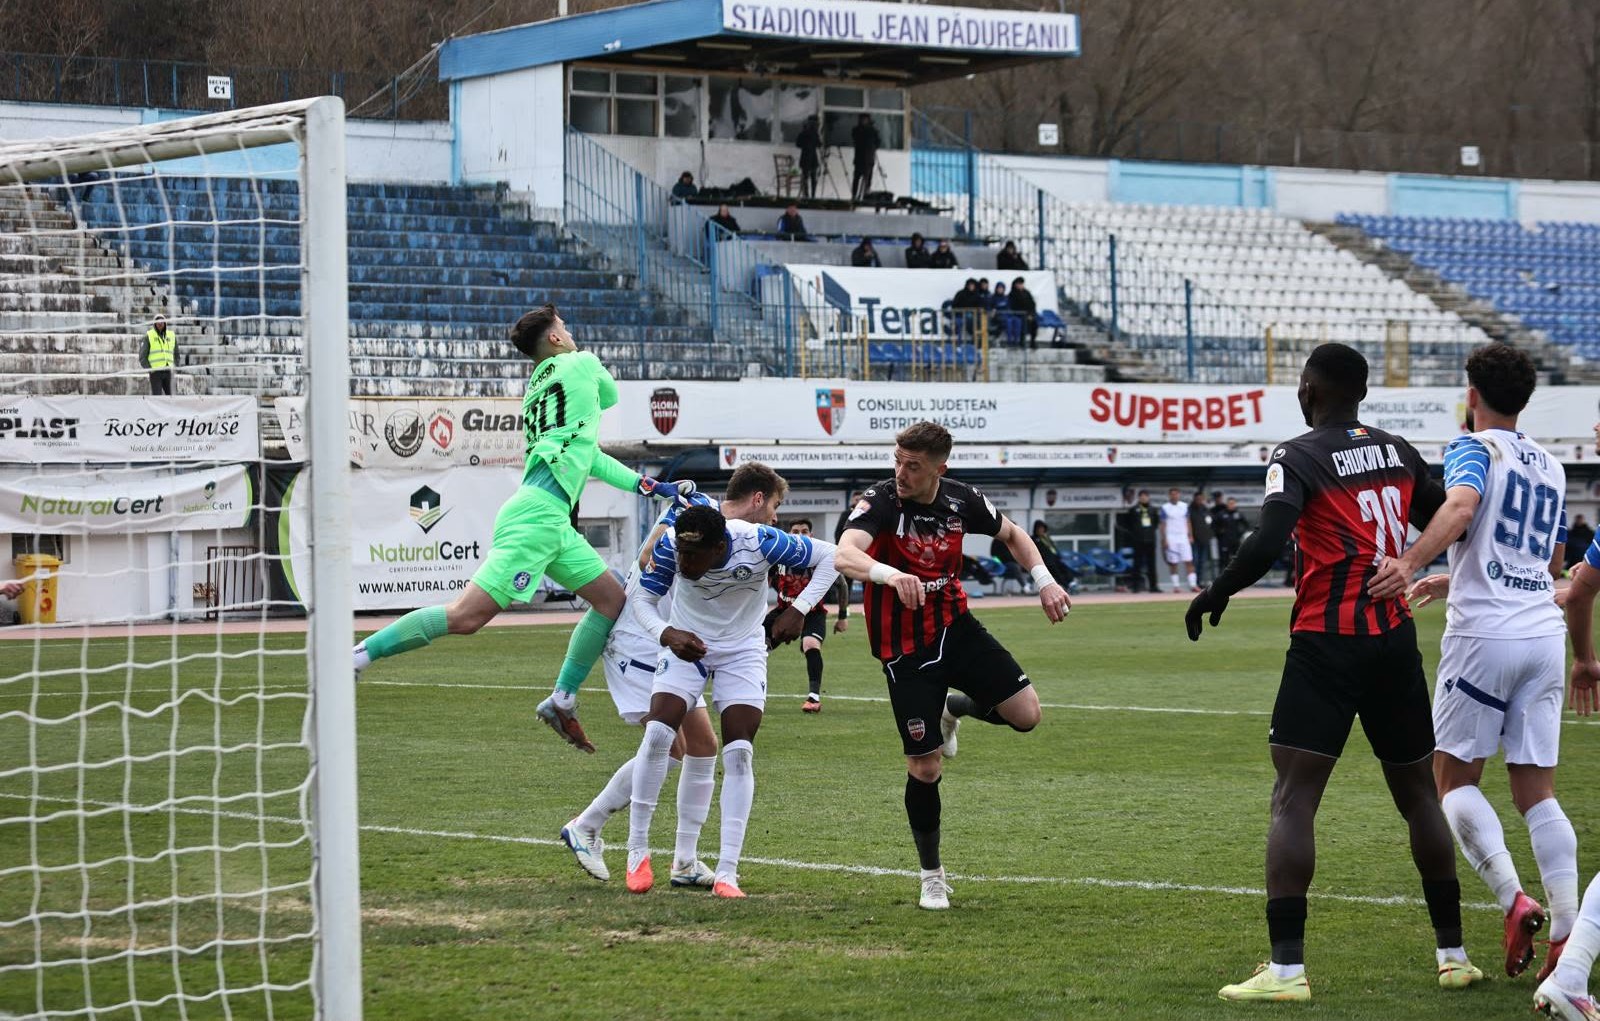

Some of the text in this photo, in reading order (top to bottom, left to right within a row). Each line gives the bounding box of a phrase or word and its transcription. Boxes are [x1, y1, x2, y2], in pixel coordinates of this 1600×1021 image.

[732, 5, 864, 40] STADIONUL
[872, 14, 929, 43] JEAN
[214, 86, 225, 95] C1
[857, 399, 926, 411] CONSILIUL
[1089, 387, 1265, 431] SUPERBET
[104, 418, 239, 437] RoSer House
[1331, 444, 1386, 477] CHUKWU
[20, 496, 164, 515] NaturalCert
[1494, 469, 1559, 561] 99
[369, 541, 479, 562] NaturalCert
